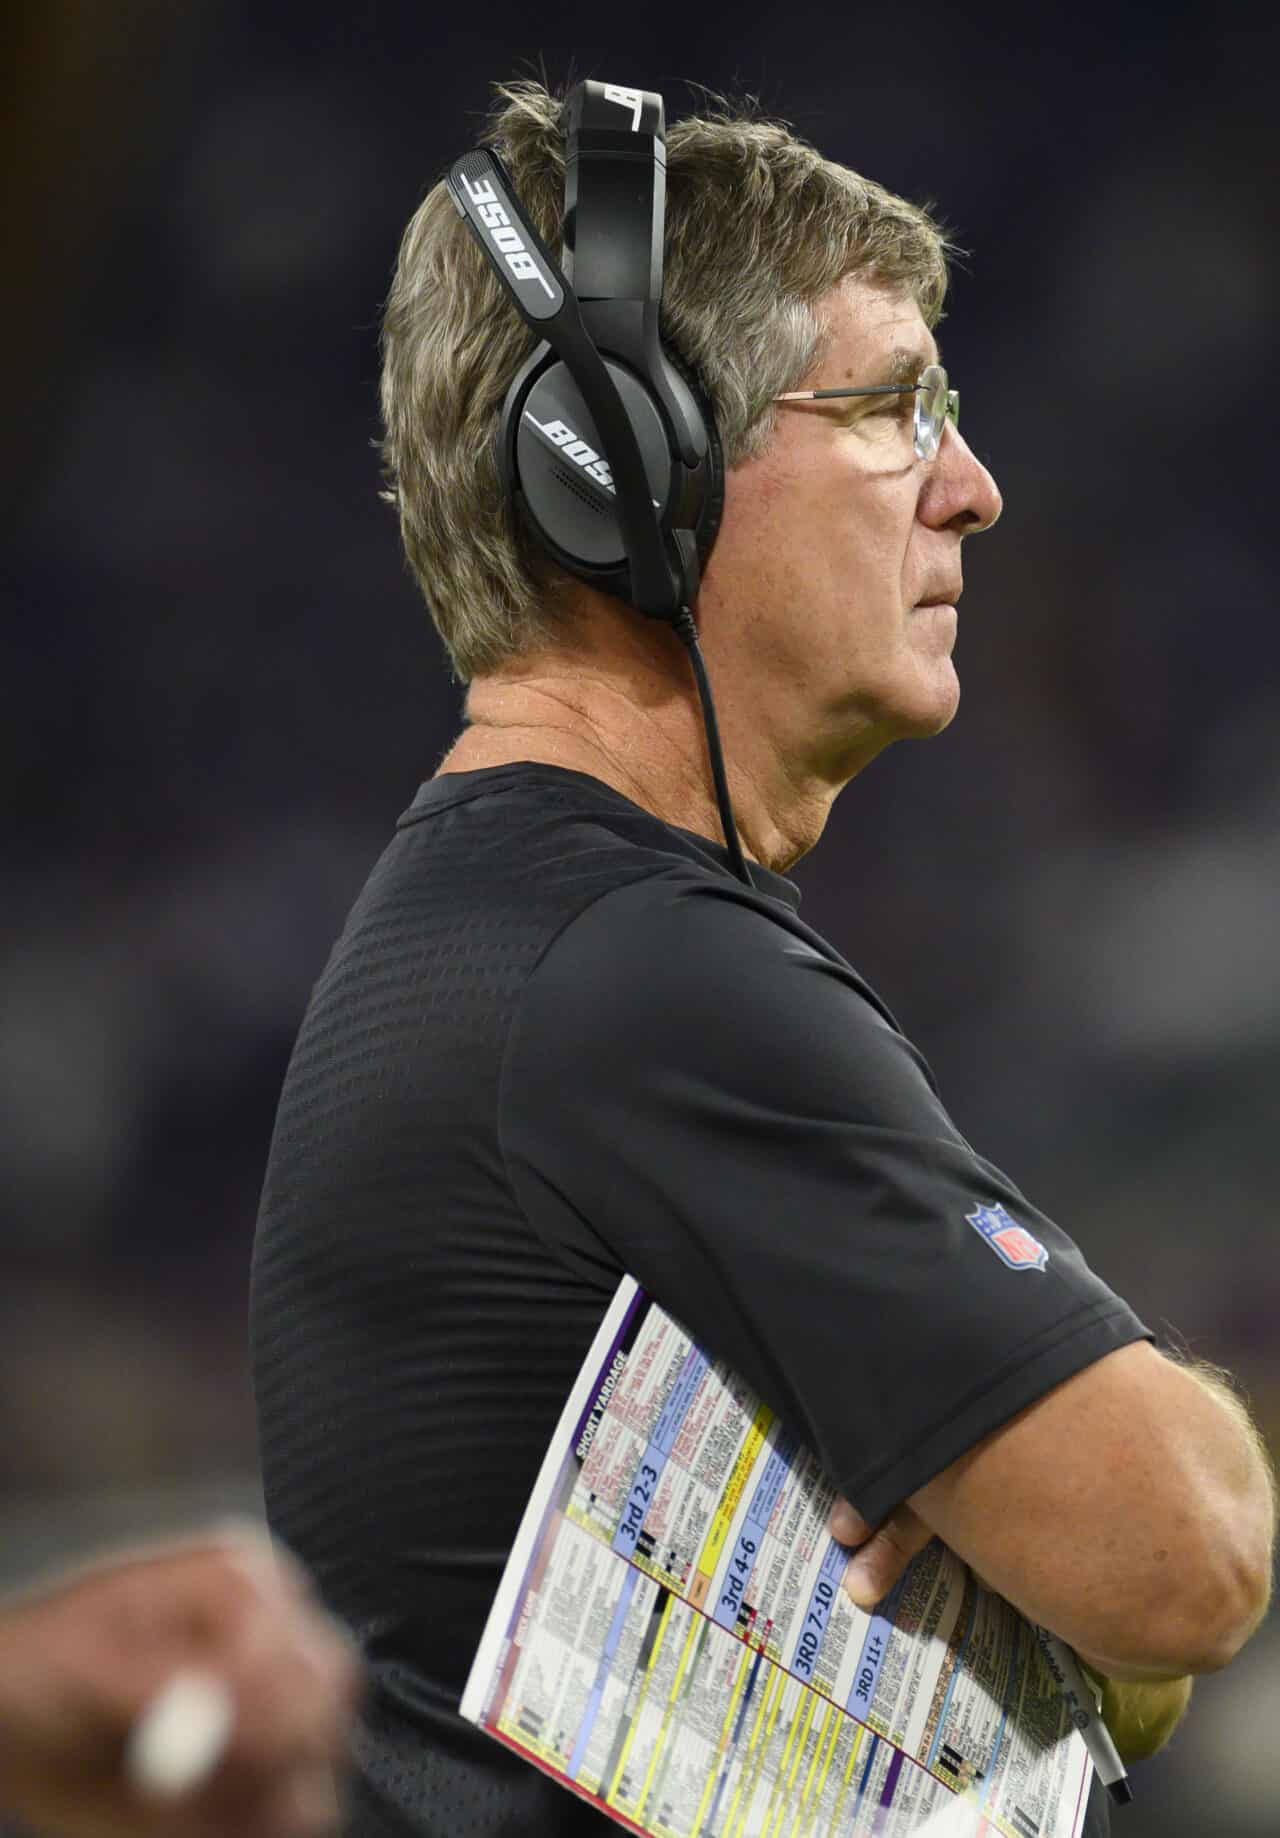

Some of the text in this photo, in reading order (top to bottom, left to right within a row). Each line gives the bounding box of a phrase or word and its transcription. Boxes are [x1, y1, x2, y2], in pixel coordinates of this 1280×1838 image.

[460, 172, 555, 299] BOSE
[525, 411, 617, 495] BOS
[576, 1415, 601, 1460] SHORT
[595, 1351, 627, 1414] YARDAGE
[621, 1502, 643, 1541] 3rd
[634, 1465, 657, 1502] 2-3
[722, 1537, 756, 1612] 3rd 4-6
[795, 1631, 819, 1675] 3RD
[808, 1582, 833, 1631] 7-10
[856, 1635, 883, 1702] 3RD 11+
